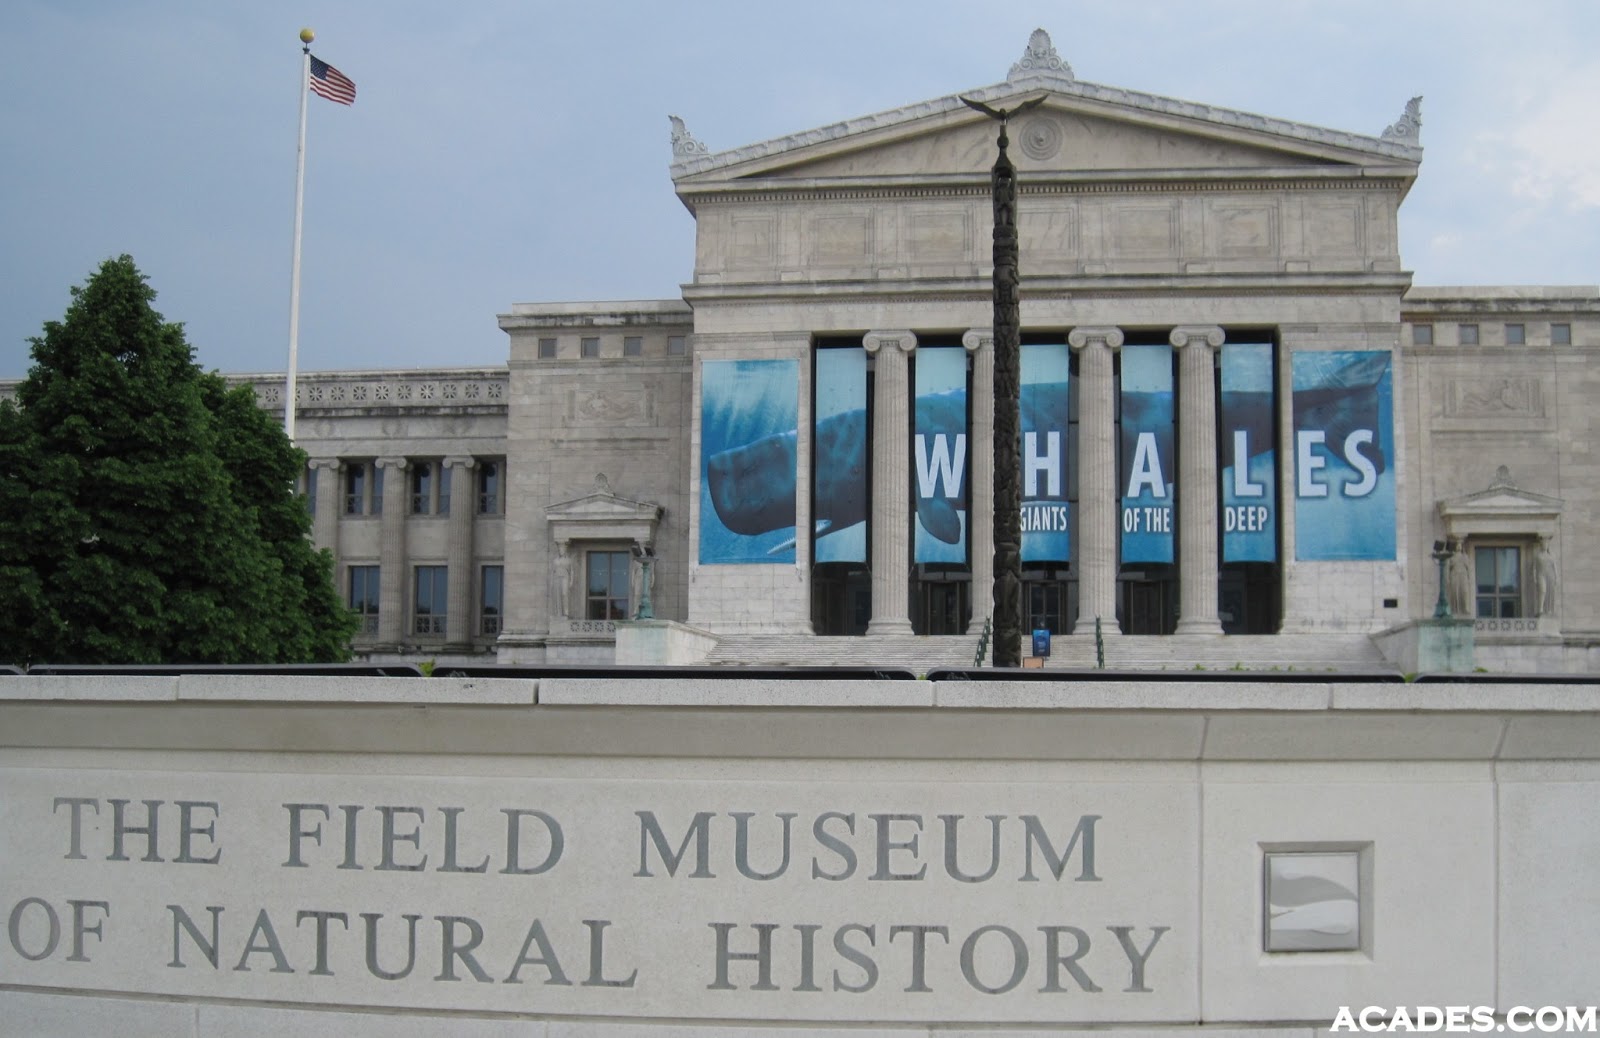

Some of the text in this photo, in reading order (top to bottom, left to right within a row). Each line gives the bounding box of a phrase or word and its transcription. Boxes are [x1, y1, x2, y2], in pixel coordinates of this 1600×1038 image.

[914, 429, 1377, 498] WHALES
[1020, 506, 1268, 532] GIANTS OF THE DEEP
[53, 797, 1102, 884] THE FIELD MUSEUM
[8, 896, 1171, 995] OF NATURAL HISTORY
